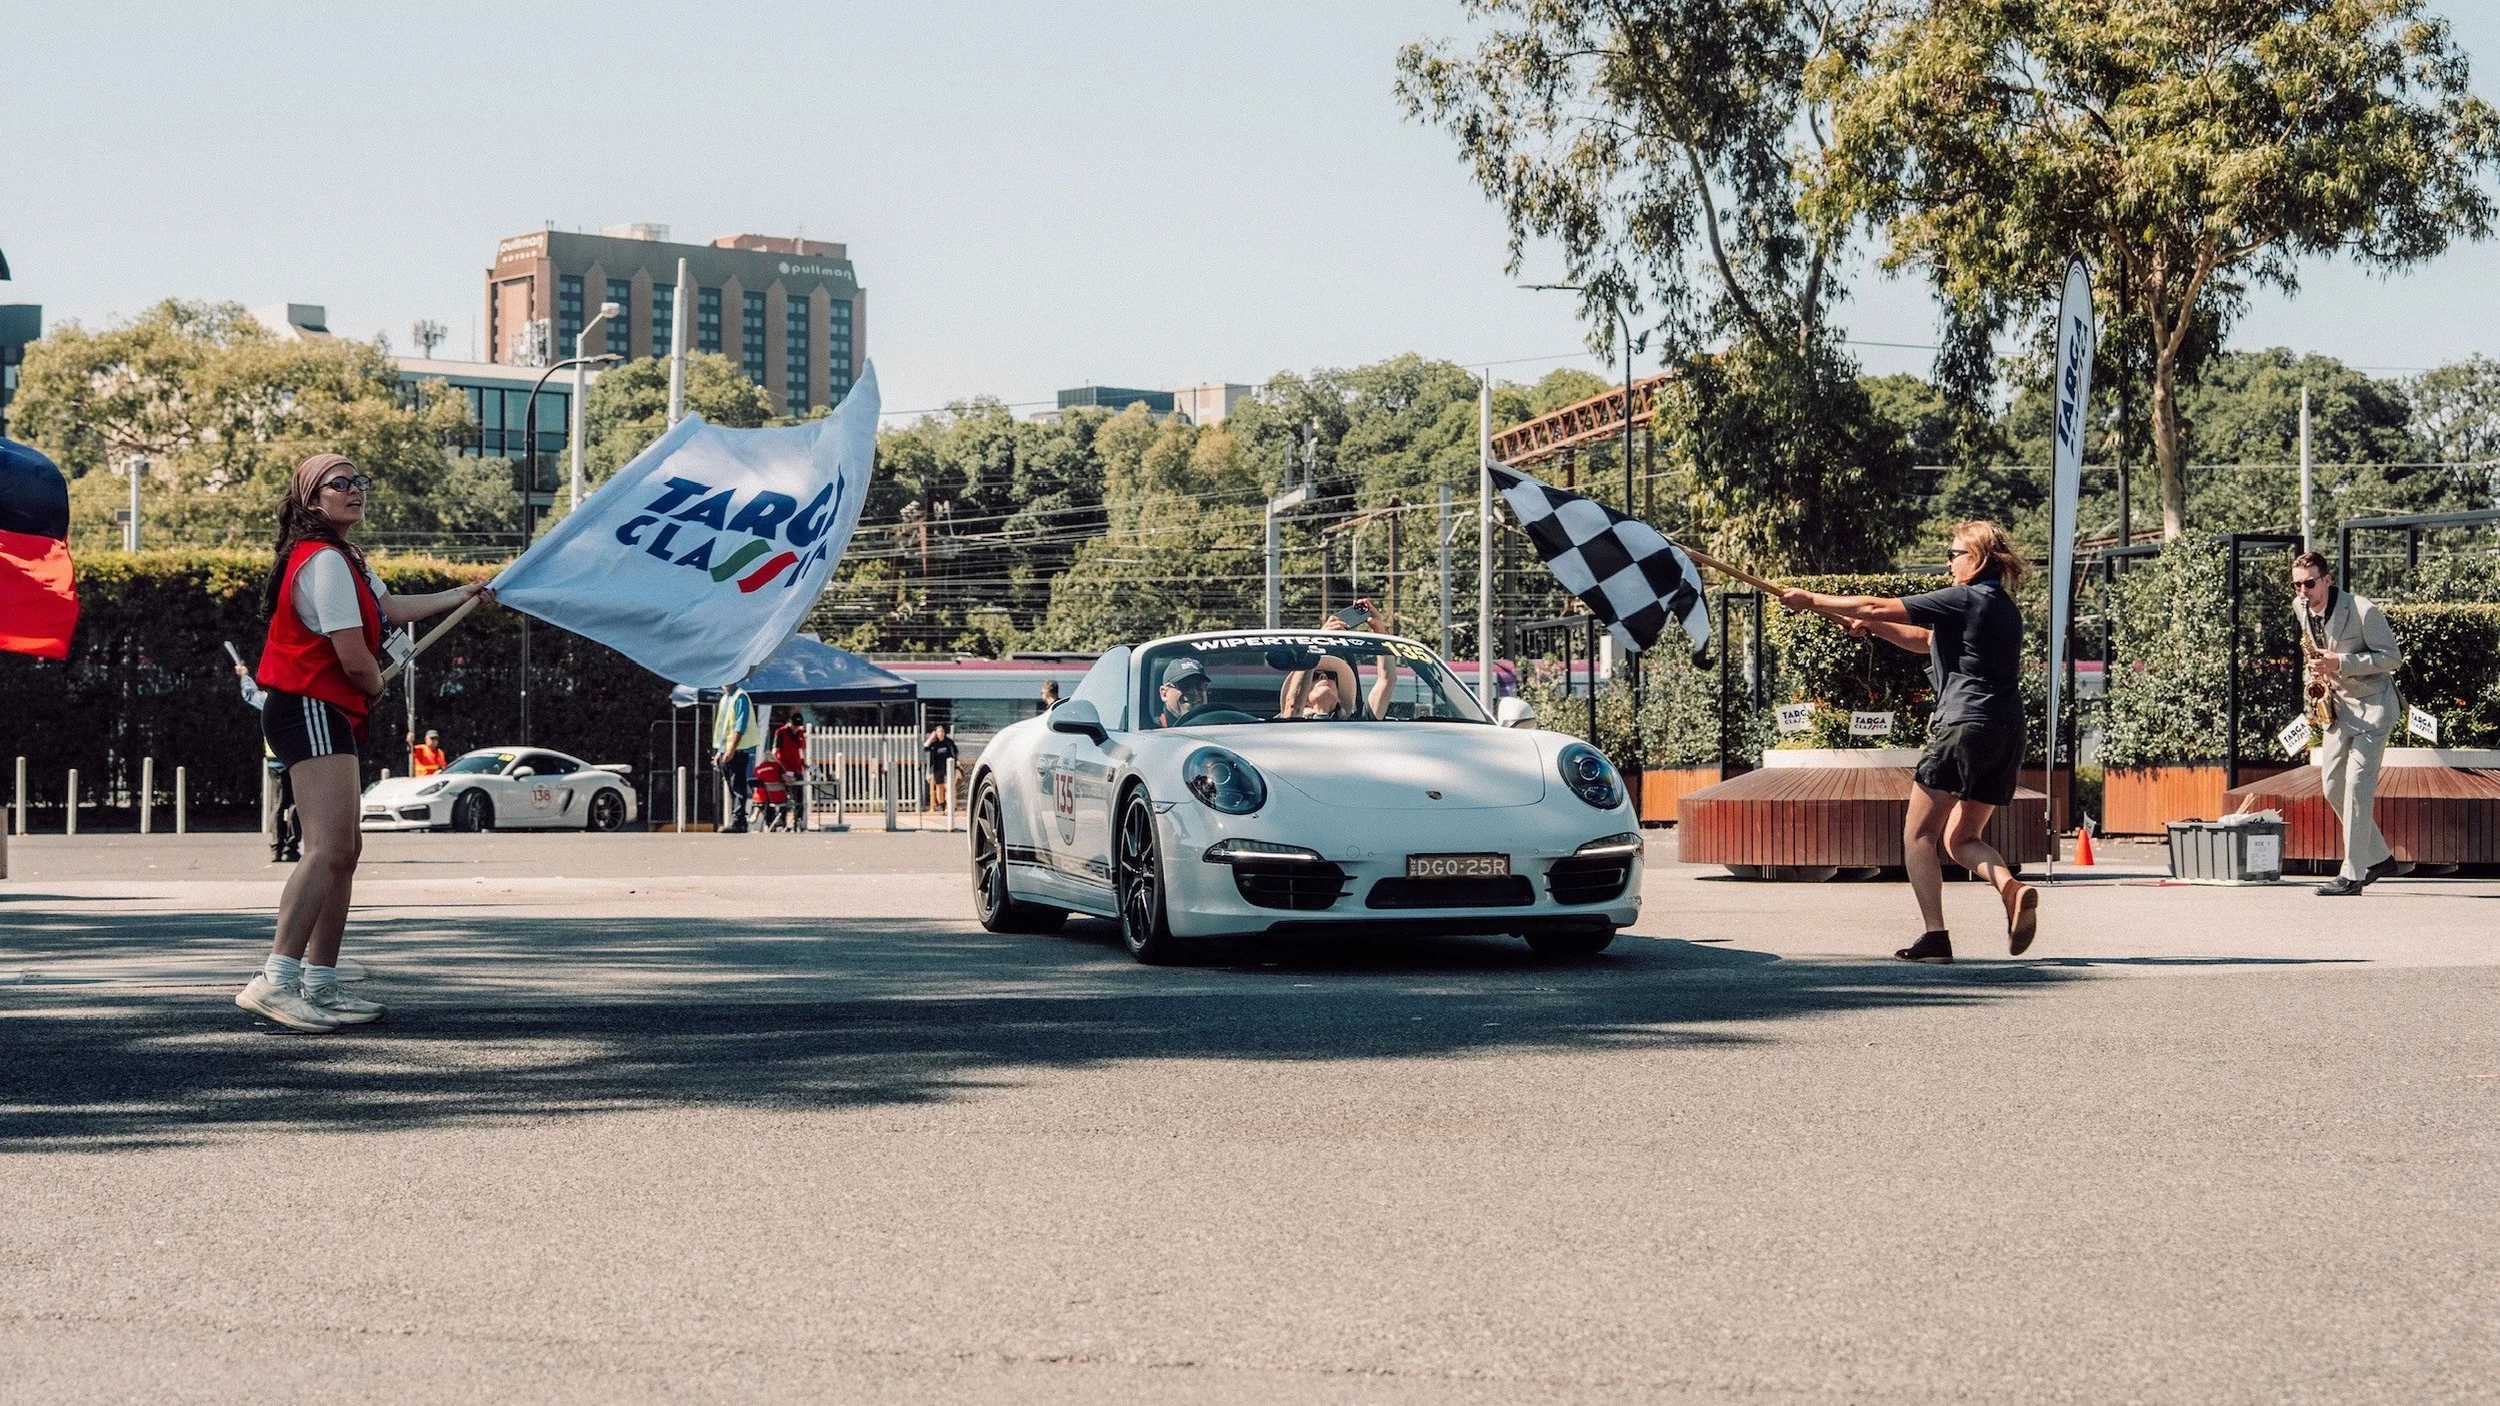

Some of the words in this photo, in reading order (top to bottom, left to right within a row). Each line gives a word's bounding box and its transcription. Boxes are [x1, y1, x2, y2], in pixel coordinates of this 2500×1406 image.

[791, 264, 853, 281] pullman
[2058, 315, 2083, 448] TARGA
[1191, 635, 1350, 651] WIPERTECH
[1381, 641, 1433, 665] 135
[1855, 716, 1886, 724] TARGA
[2283, 723, 2306, 743] TARGA
[532, 789, 551, 801] 138
[1056, 773, 1074, 815] 135
